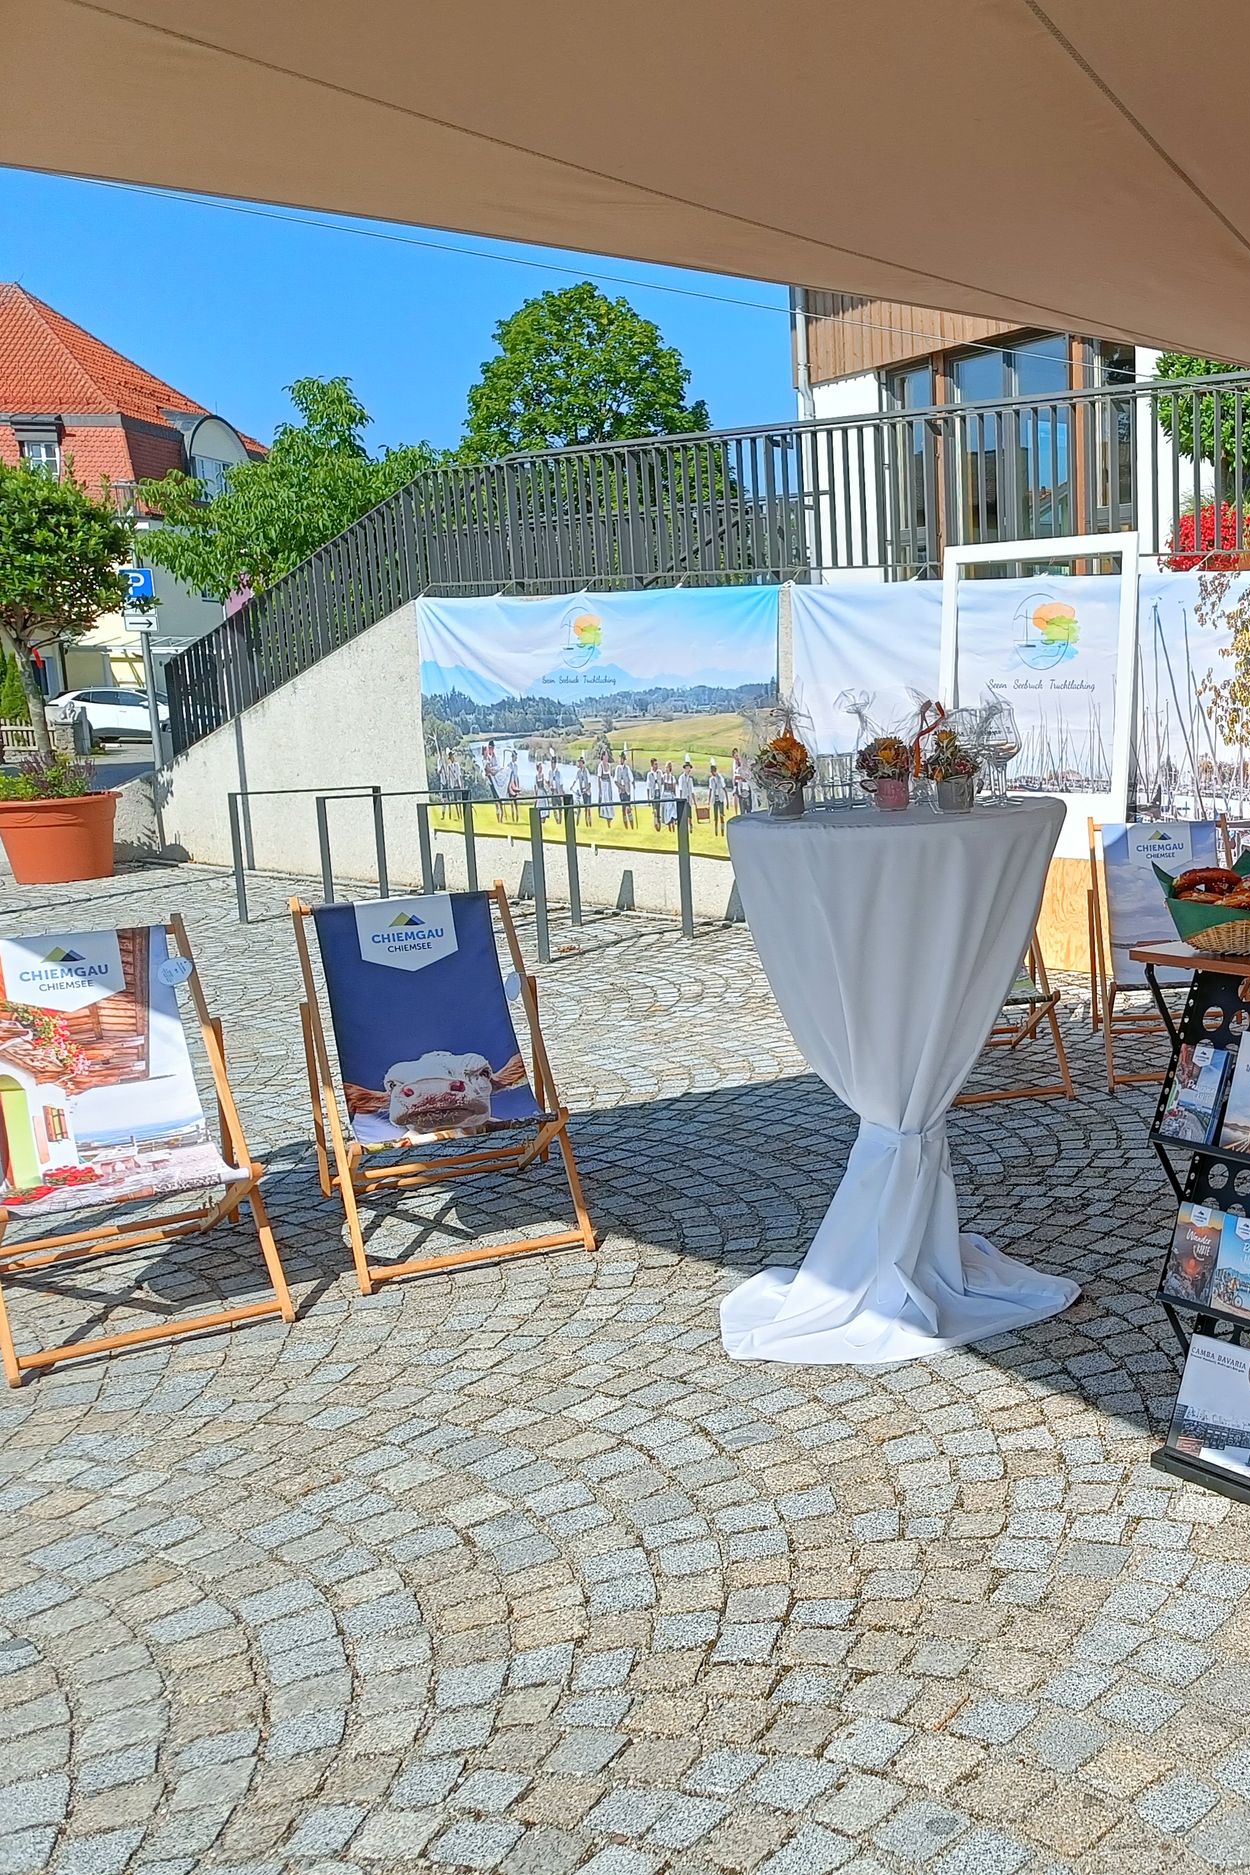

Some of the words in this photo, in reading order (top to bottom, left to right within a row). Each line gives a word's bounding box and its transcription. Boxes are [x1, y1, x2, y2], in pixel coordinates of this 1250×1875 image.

[127, 572, 145, 596] P
[988, 679, 1007, 690] Seeon
[1013, 679, 1043, 690] Seebruck
[1049, 679, 1096, 692] Truchtlaching
[1135, 843, 1184, 852] CHIEMGAU
[371, 928, 445, 944] CHIEMGAU
[387, 942, 433, 953] CHIEMSEE
[19, 964, 109, 982] CHIEMGAU
[39, 980, 94, 992] CHIEMSEE
[1191, 1346, 1215, 1360] CAMBA
[1217, 1354, 1246, 1370] BAVARIA
